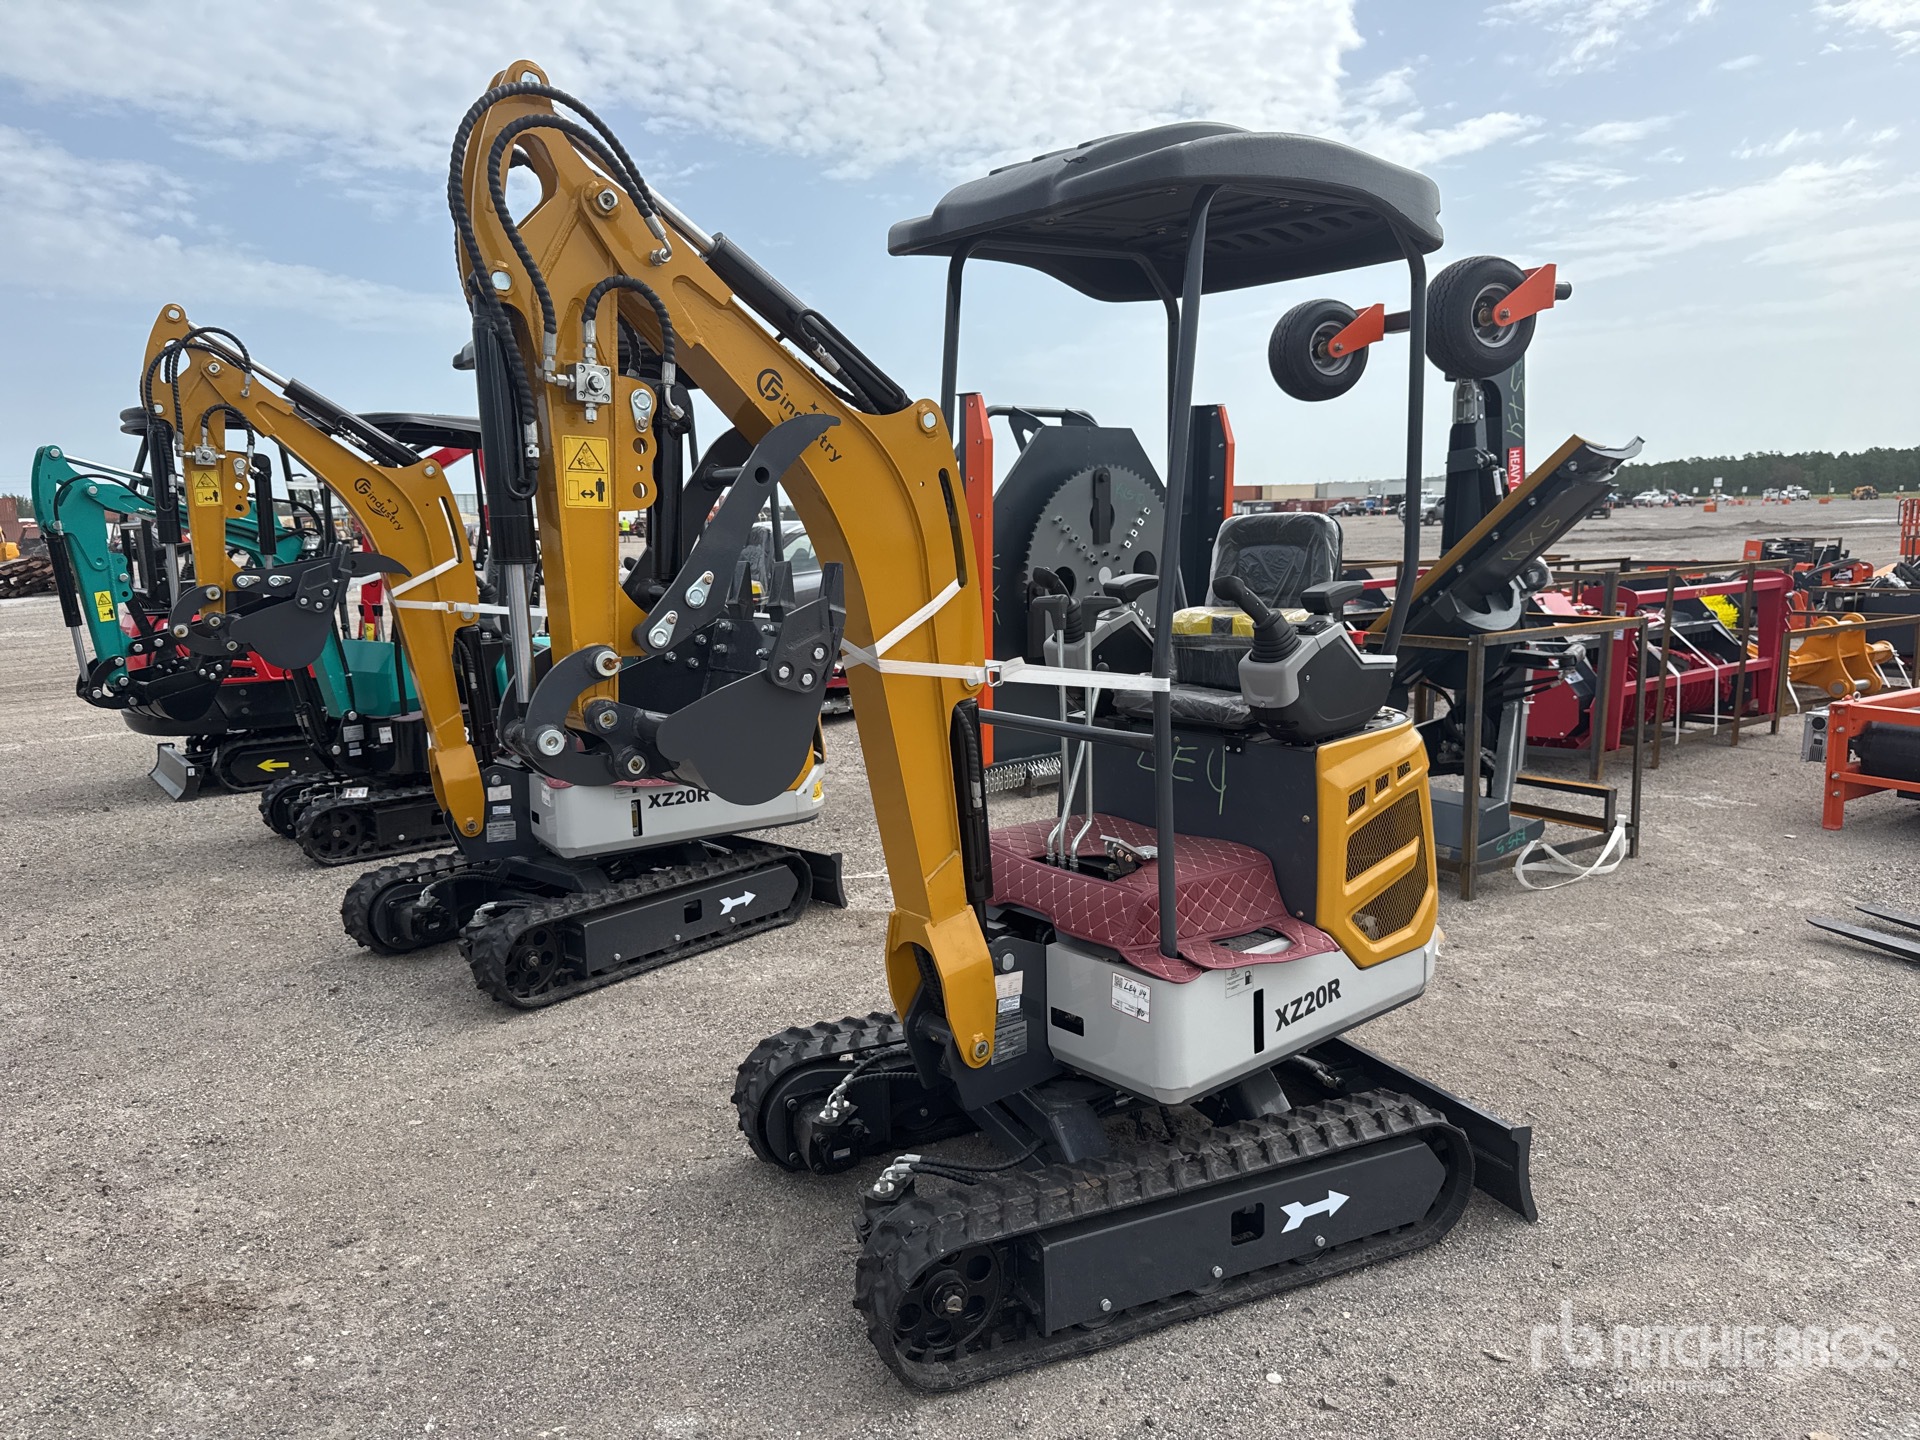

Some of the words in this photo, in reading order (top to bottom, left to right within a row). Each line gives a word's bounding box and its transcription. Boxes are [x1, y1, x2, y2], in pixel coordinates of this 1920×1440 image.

[1509, 449, 1521, 484] HEAVY
[648, 788, 710, 809] XZ20R
[1274, 977, 1343, 1033] XZ20R
